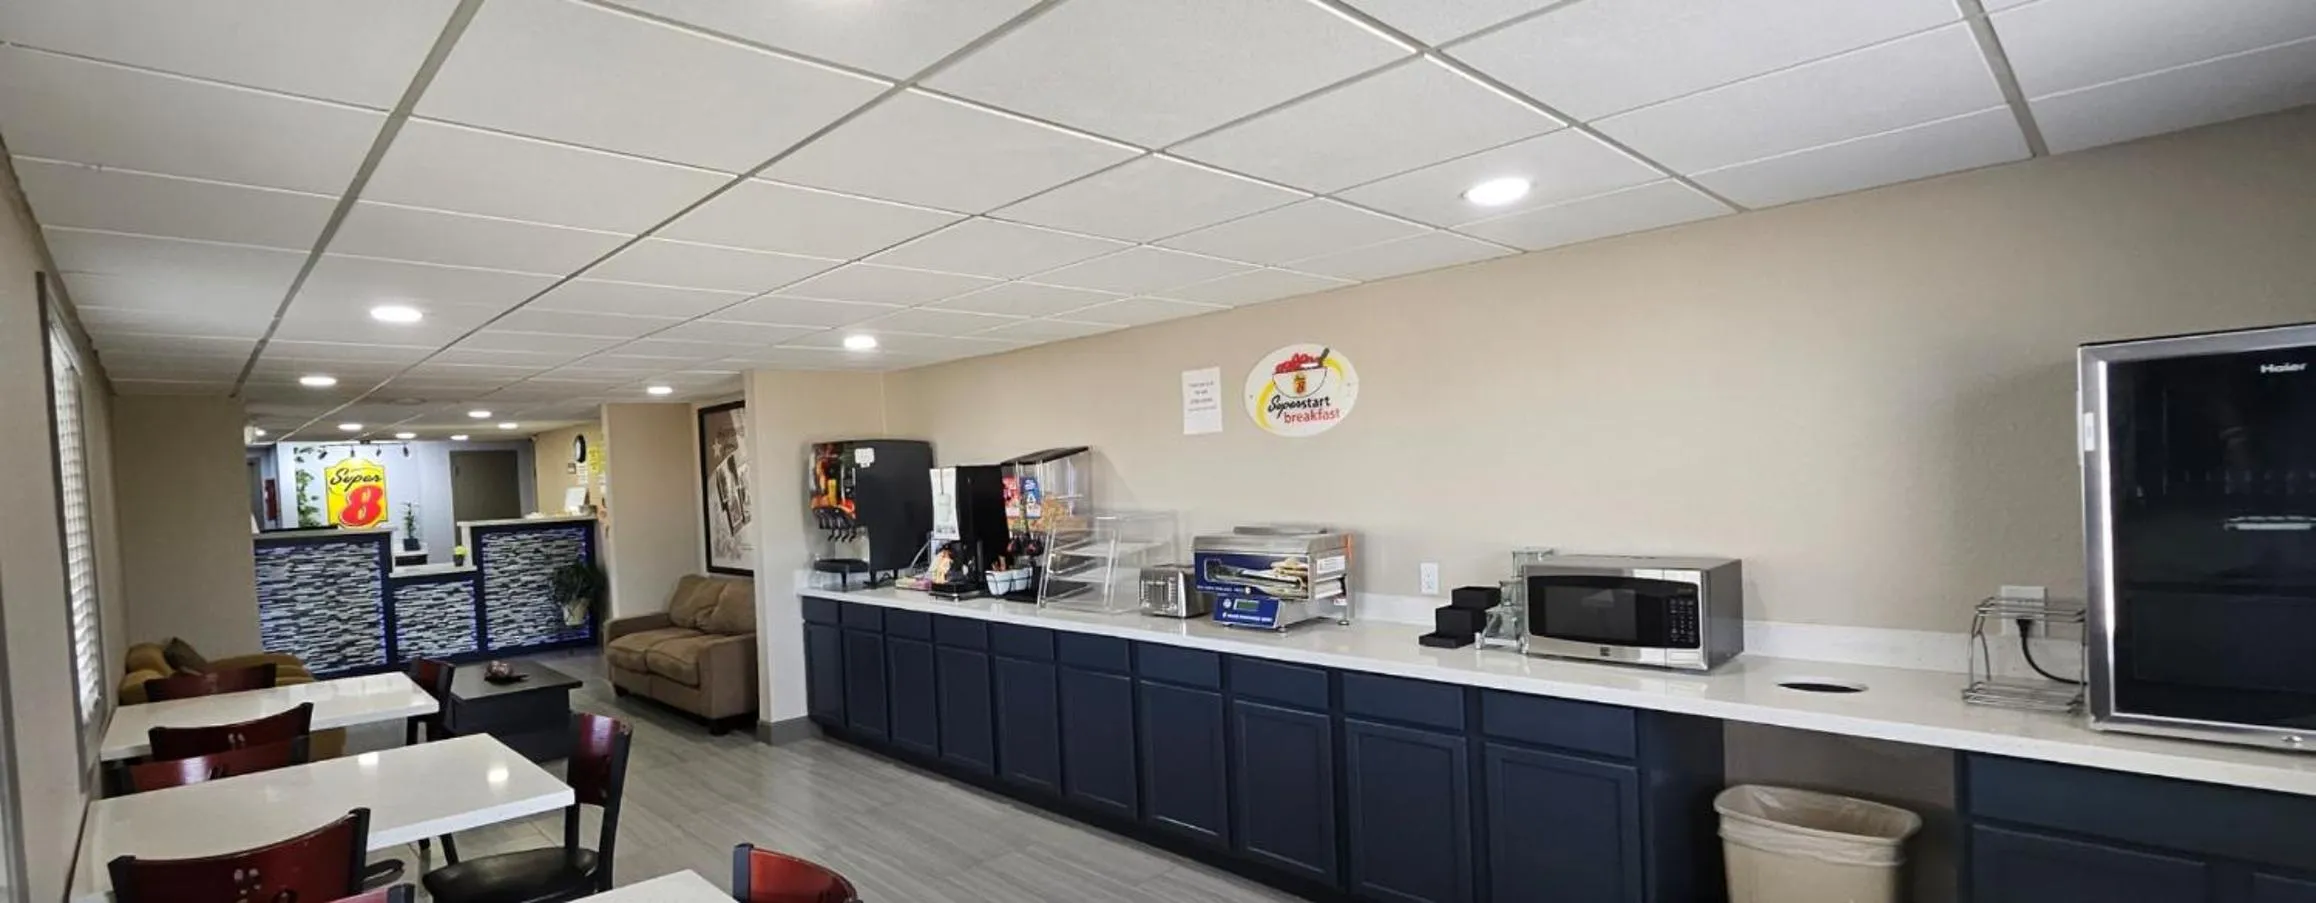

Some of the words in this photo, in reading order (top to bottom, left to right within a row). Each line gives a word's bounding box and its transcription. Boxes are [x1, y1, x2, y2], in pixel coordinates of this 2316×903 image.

[2260, 362, 2307, 373] Haier
[1268, 395, 1330, 419] Superstart
[1284, 408, 1340, 423] breakfast
[330, 468, 382, 492] Super
[341, 485, 384, 527] 8
